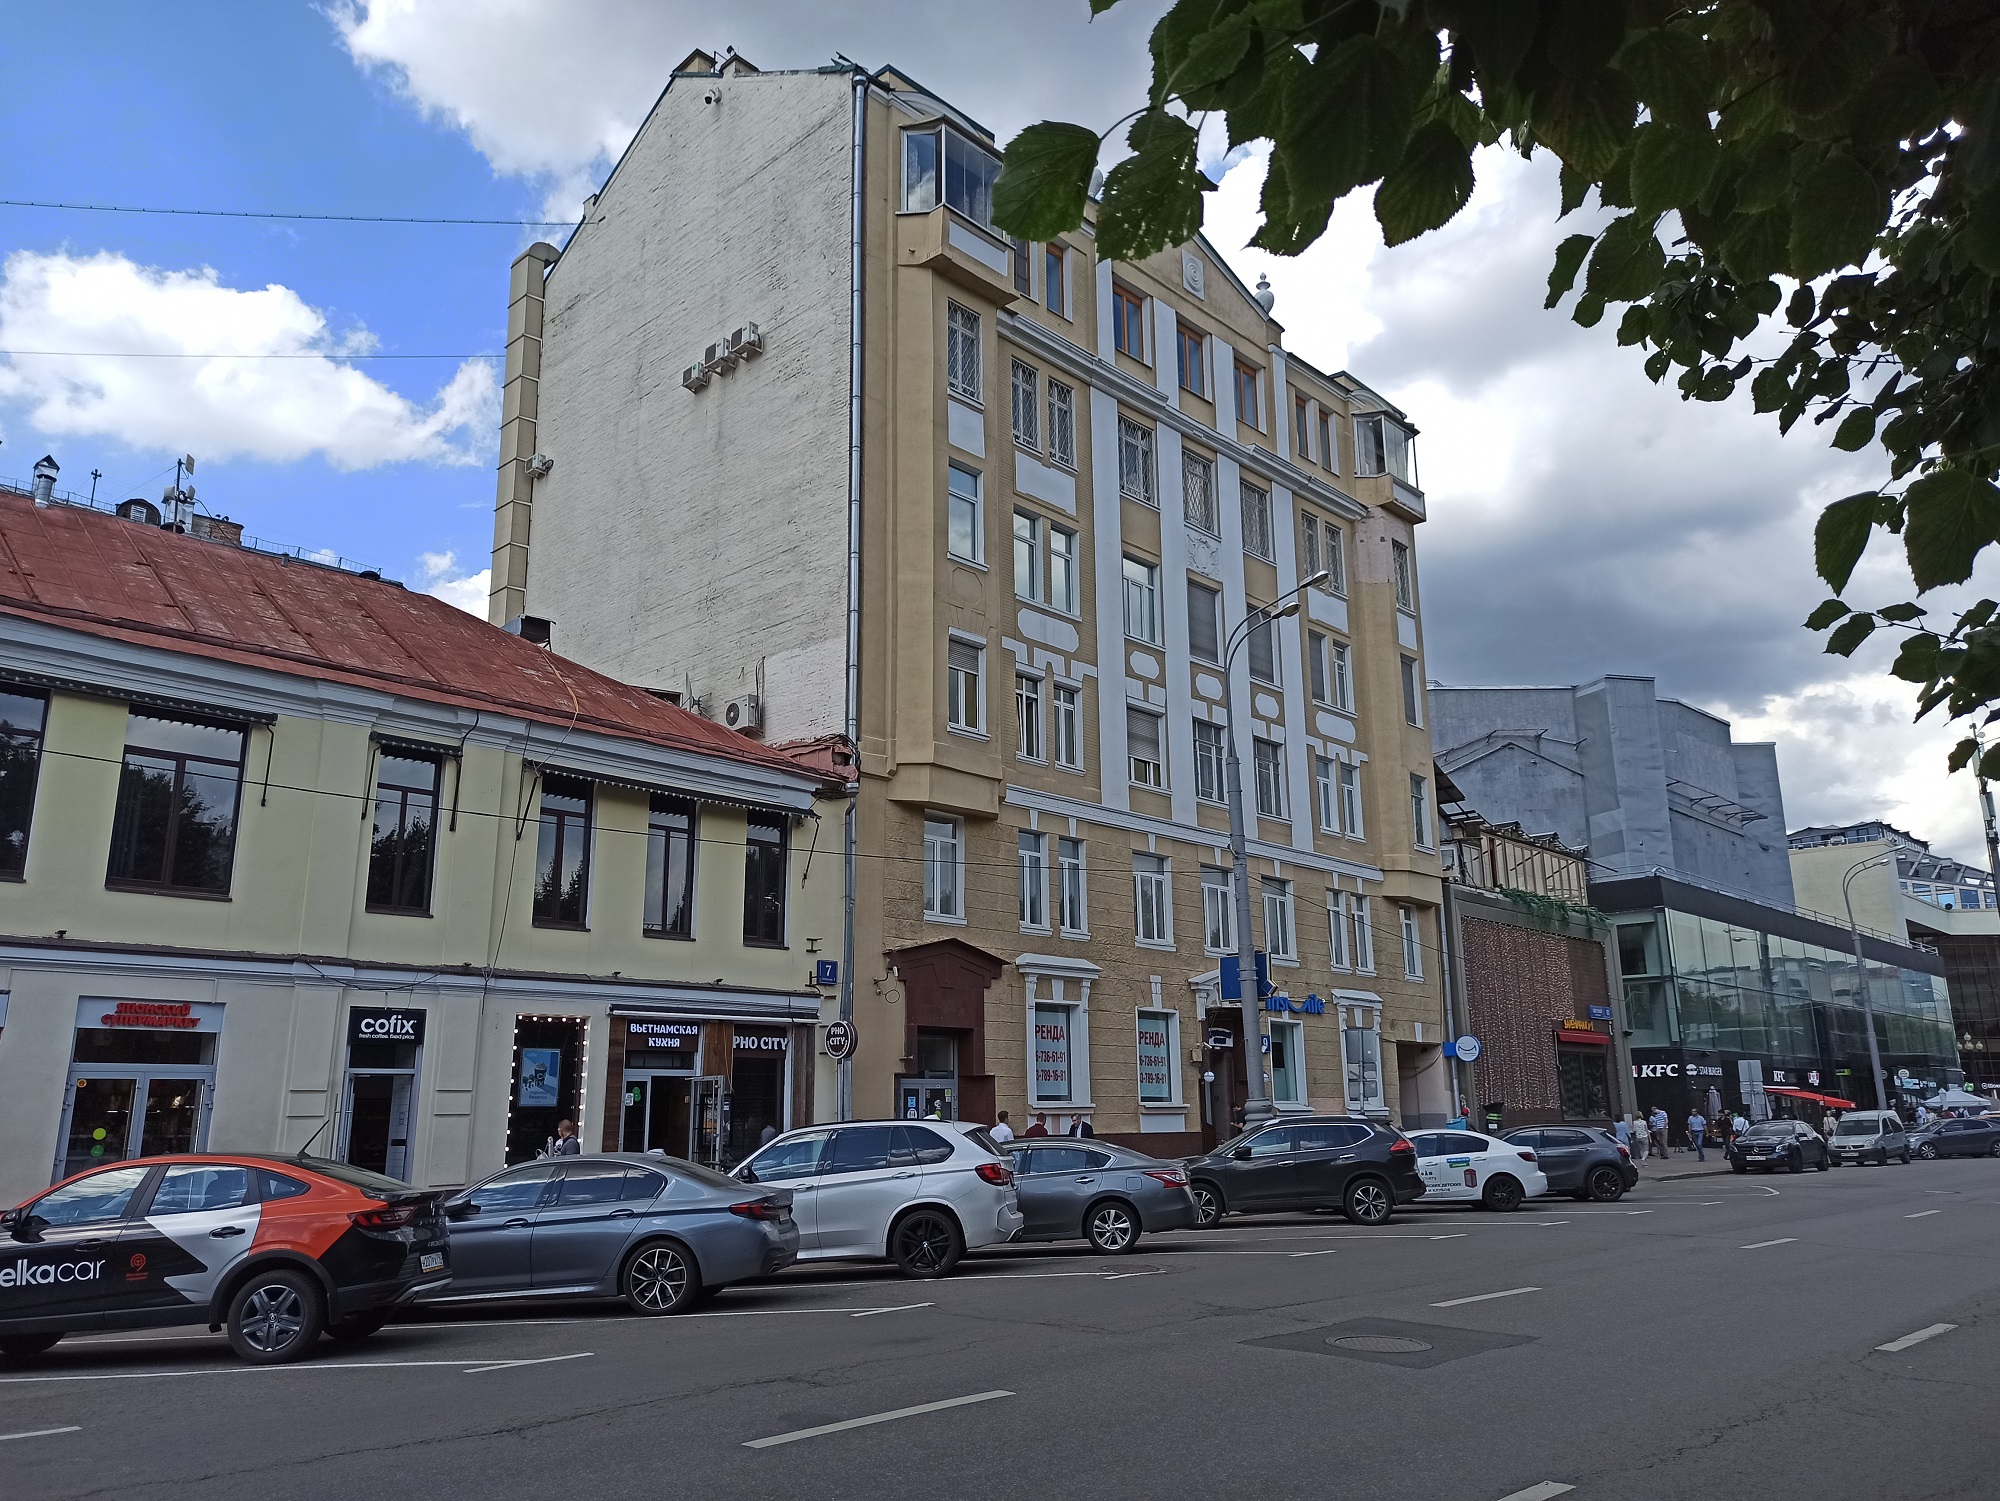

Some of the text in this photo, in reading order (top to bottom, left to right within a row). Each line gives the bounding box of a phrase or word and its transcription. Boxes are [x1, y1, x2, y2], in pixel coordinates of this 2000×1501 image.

[825, 964, 832, 977] 7
[115, 1001, 192, 1017] ЯПОНСКИЙ
[101, 1013, 201, 1028] СУПЕРМАРКЕТ
[360, 1014, 415, 1034] cofix
[630, 1023, 698, 1035] ВЬЕТНАМСКАЯ
[830, 1026, 845, 1035] PHO
[648, 1037, 681, 1048] КУХНЯ
[733, 1035, 789, 1051] PHO CITY
[829, 1036, 846, 1046] CITY
[1640, 1063, 1679, 1078] KFC
[1773, 1070, 1786, 1082] KFC
[0, 1258, 106, 1288] elkacar
